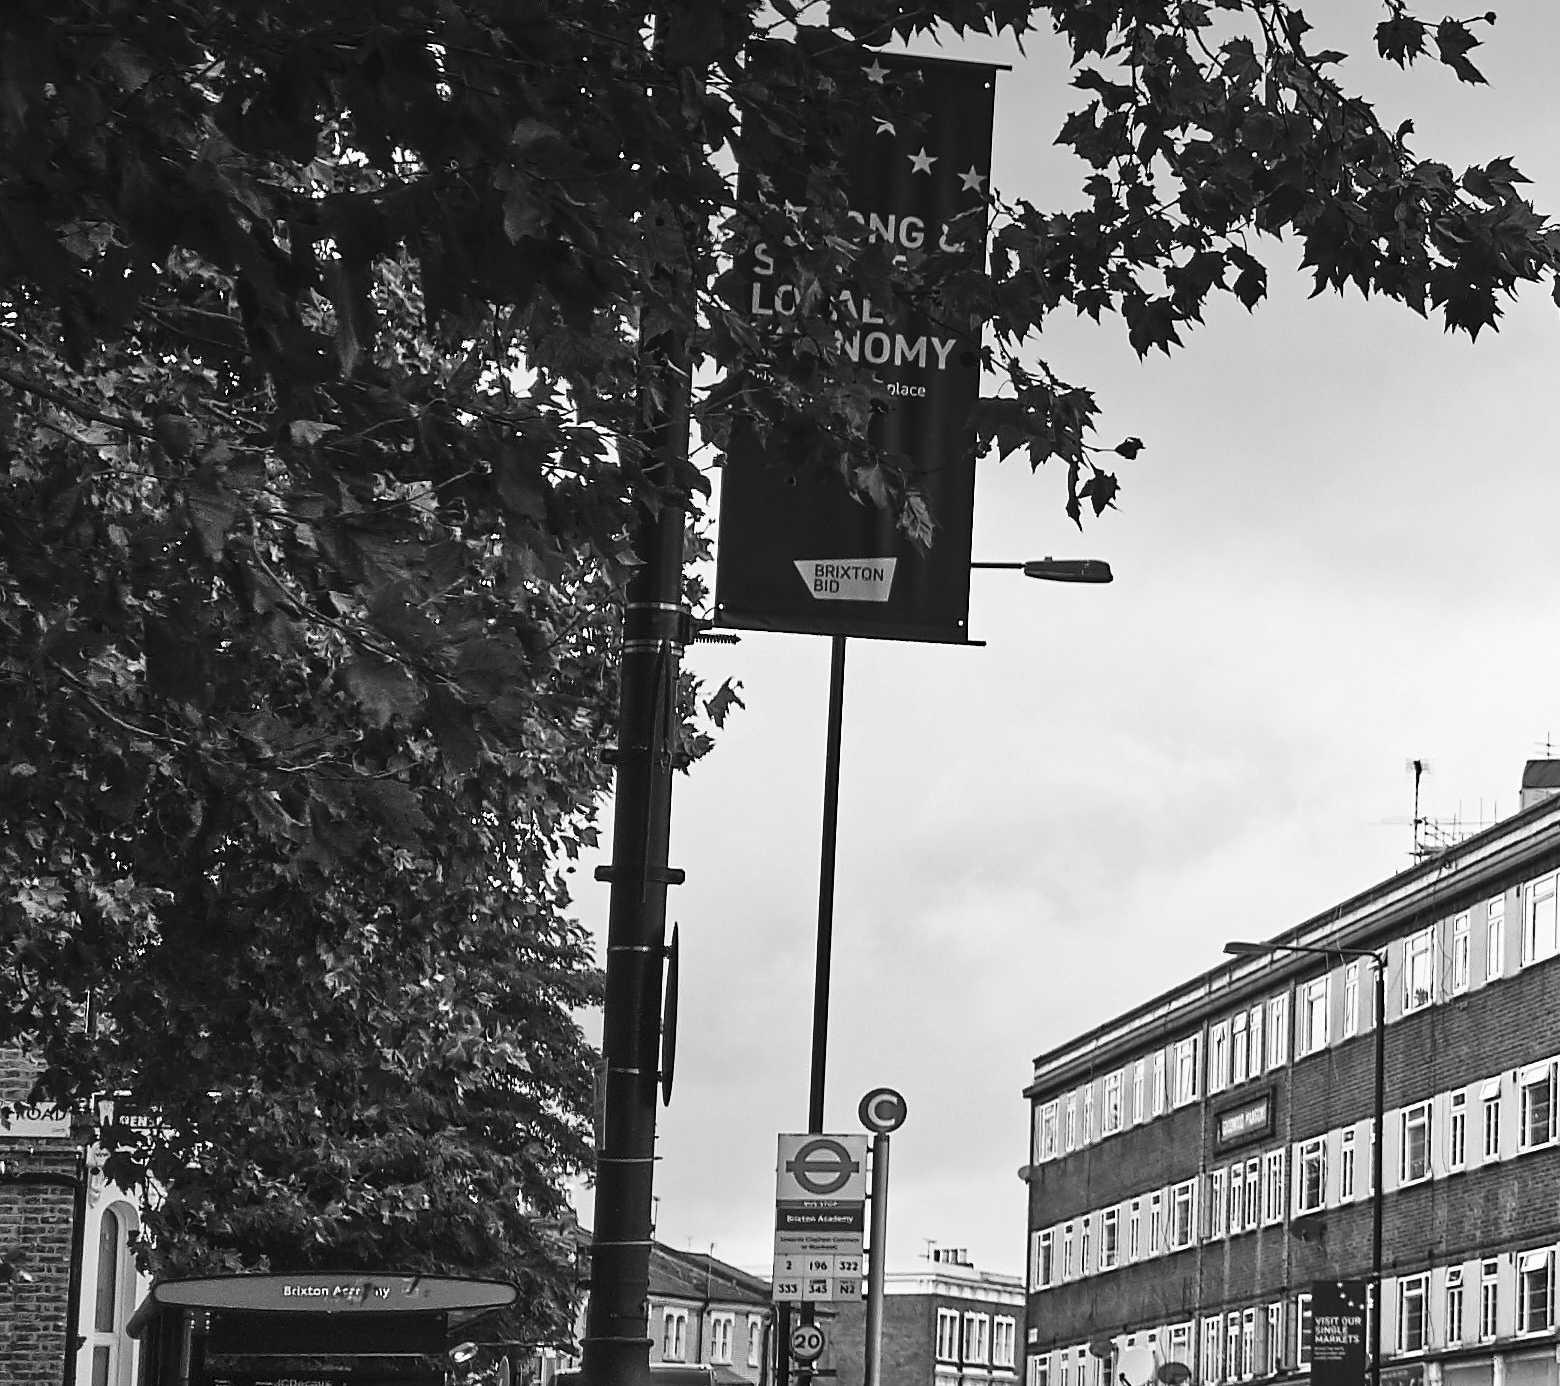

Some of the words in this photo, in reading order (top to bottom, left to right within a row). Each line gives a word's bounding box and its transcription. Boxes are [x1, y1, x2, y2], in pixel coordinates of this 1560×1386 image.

[752, 282, 884, 325] LOAL
[814, 563, 885, 582] BRIXTON
[813, 579, 840, 594] BID
[787, 1214, 816, 1223] Brixton
[818, 1214, 854, 1224] Academy
[786, 1260, 792, 1270] 2
[809, 1260, 828, 1271] 196
[839, 1260, 858, 1271] 322
[283, 1285, 329, 1296] Brixton
[778, 1283, 798, 1294] 333
[840, 1284, 855, 1294] N2
[1315, 1316, 1339, 1326] VISIT
[1341, 1316, 1361, 1326] OUR
[1315, 1326, 1348, 1335] SINGLE
[794, 1334, 820, 1349] 20
[1315, 1334, 1360, 1344] MARKETS
